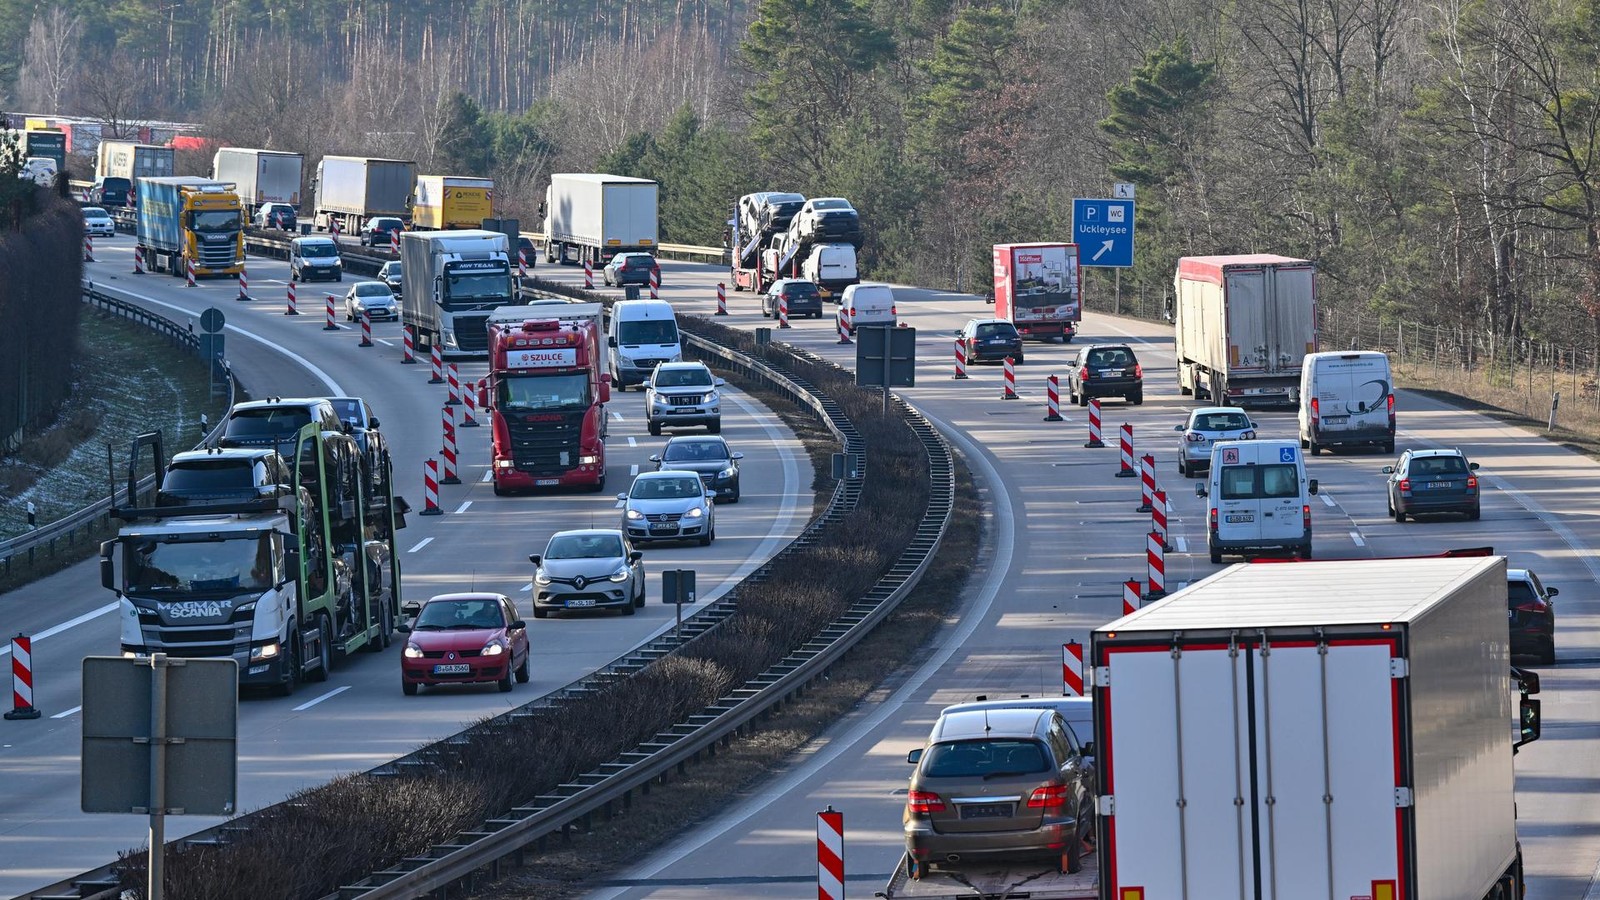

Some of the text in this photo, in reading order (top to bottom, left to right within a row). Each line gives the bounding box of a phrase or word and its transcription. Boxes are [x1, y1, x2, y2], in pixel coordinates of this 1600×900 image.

[1087, 207, 1096, 220] P
[1080, 224, 1127, 236] Uckleysee
[530, 353, 563, 361] SZULCE
[157, 600, 233, 611] MAGMAR
[170, 607, 222, 619] SCANIA
